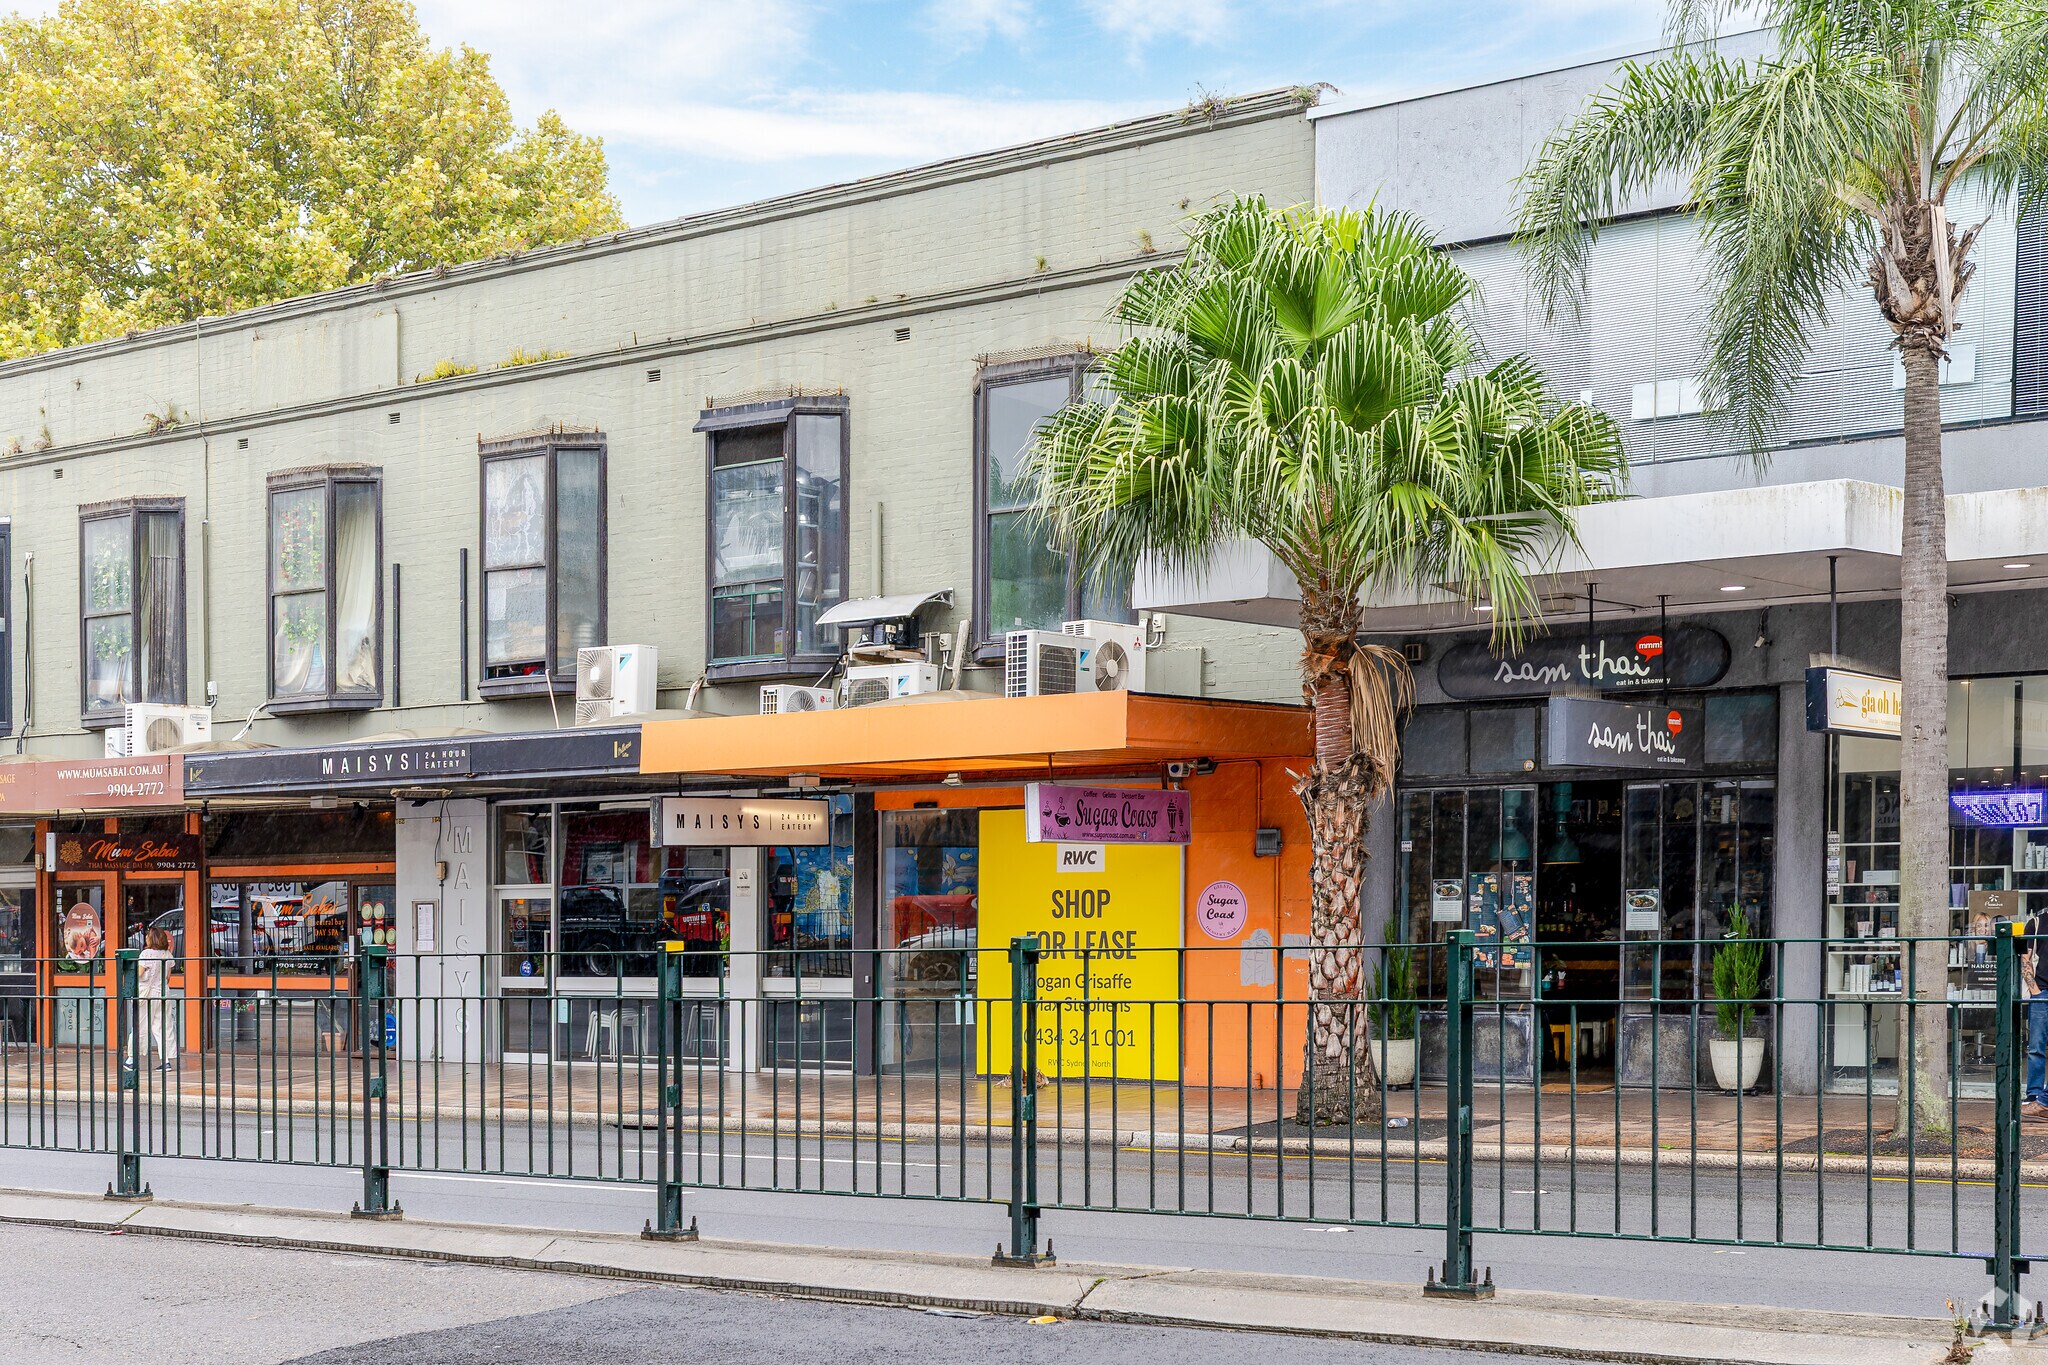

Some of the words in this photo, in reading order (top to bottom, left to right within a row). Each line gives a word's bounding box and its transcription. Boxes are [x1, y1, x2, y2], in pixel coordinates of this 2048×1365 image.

[1638, 641, 1662, 649] mmm!
[1493, 661, 1571, 685] sam
[1577, 640, 1650, 680] thai
[1641, 677, 1671, 686] takeawy
[1861, 689, 1876, 719] gia
[1878, 690, 1889, 714] oh
[1588, 722, 1634, 754] sam
[1636, 710, 1676, 755] thai
[425, 751, 436, 760] 24
[442, 749, 466, 758] HOUR
[322, 752, 409, 775] MAISYS
[425, 760, 460, 769] EATERY
[57, 765, 164, 780] WWW.MUMSABAI.COM.AU
[1083, 790, 1098, 798] Coffee
[1102, 791, 1117, 799] Gelato
[676, 813, 760, 829] MAISYS
[88, 839, 133, 862] Mum
[134, 839, 180, 862] Sabai
[1063, 850, 1098, 865] RWC
[156, 861, 175, 869] 9904
[177, 861, 196, 869] 2772
[1051, 889, 1111, 919] SHOP
[1207, 893, 1239, 907] Sugar
[1206, 908, 1235, 920] Coast
[1074, 930, 1137, 960] LEASE
[1037, 976, 1071, 992] ogan
[1104, 1029, 1136, 1047] 001
[1066, 1059, 1085, 1069] Sydne
[1091, 1060, 1112, 1069] North
